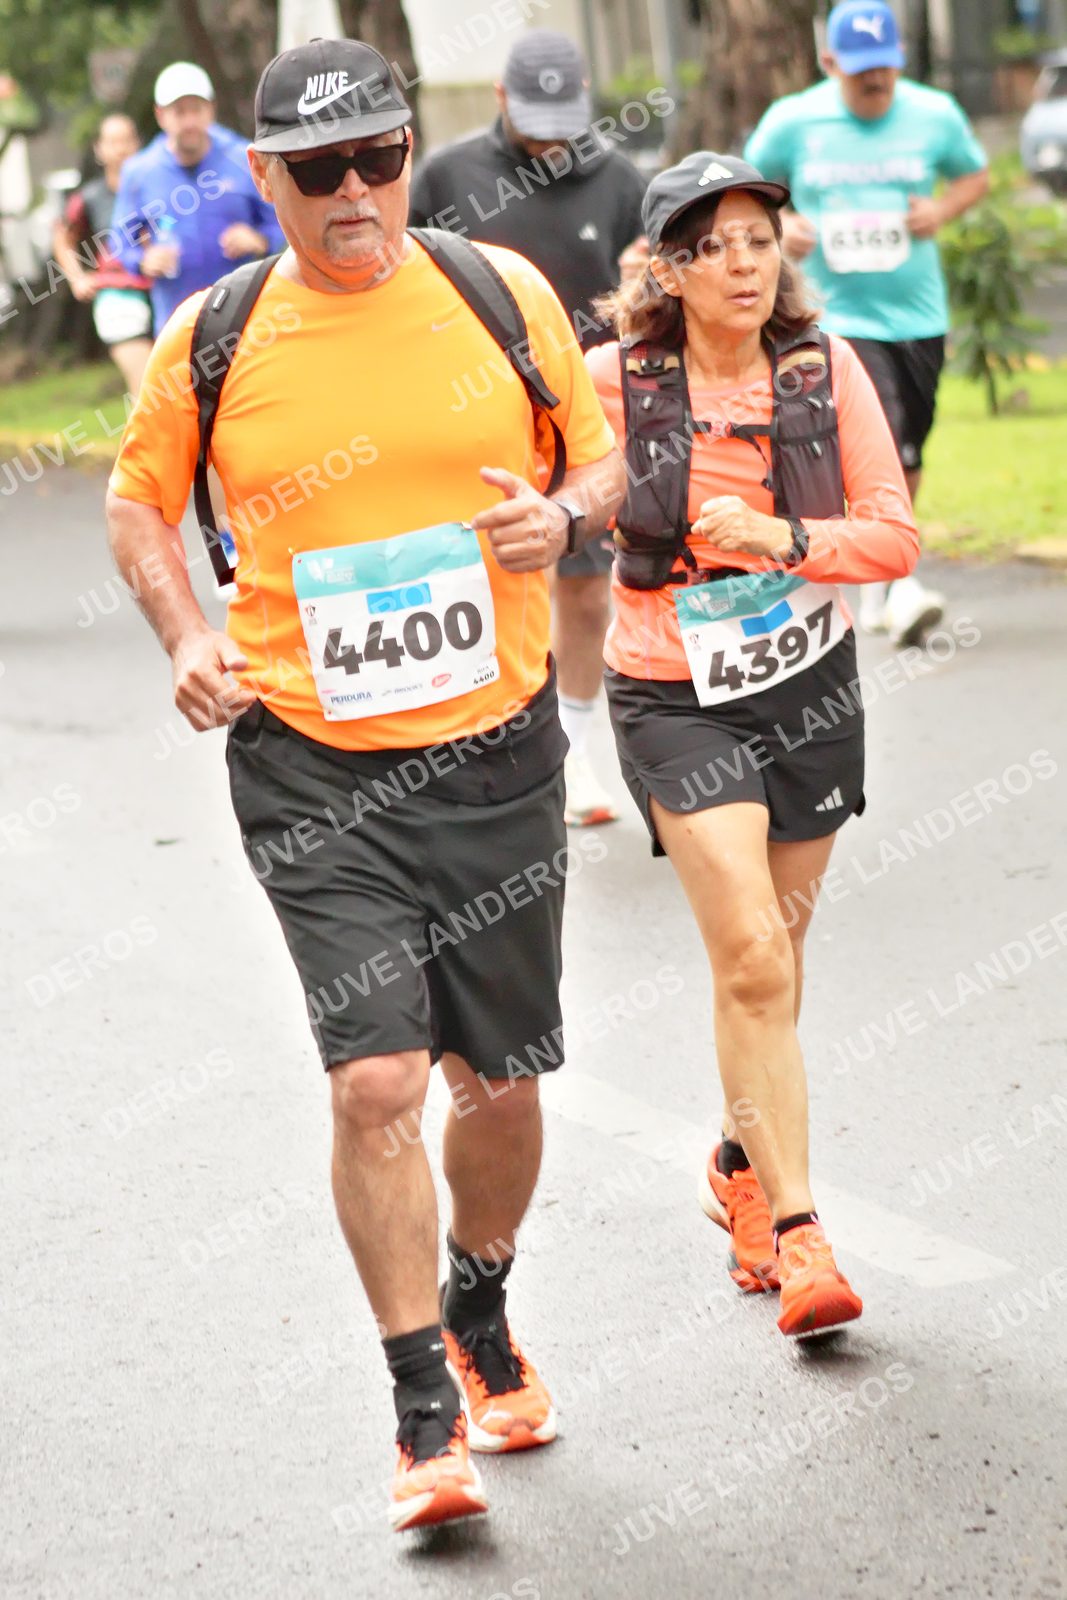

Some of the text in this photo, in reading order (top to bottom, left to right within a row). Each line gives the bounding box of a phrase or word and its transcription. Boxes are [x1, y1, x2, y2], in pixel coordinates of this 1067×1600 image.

[304, 71, 349, 100] NIKE
[322, 601, 483, 676] 4400
[708, 600, 833, 692] 4397
[330, 691, 373, 705] PERDURA
